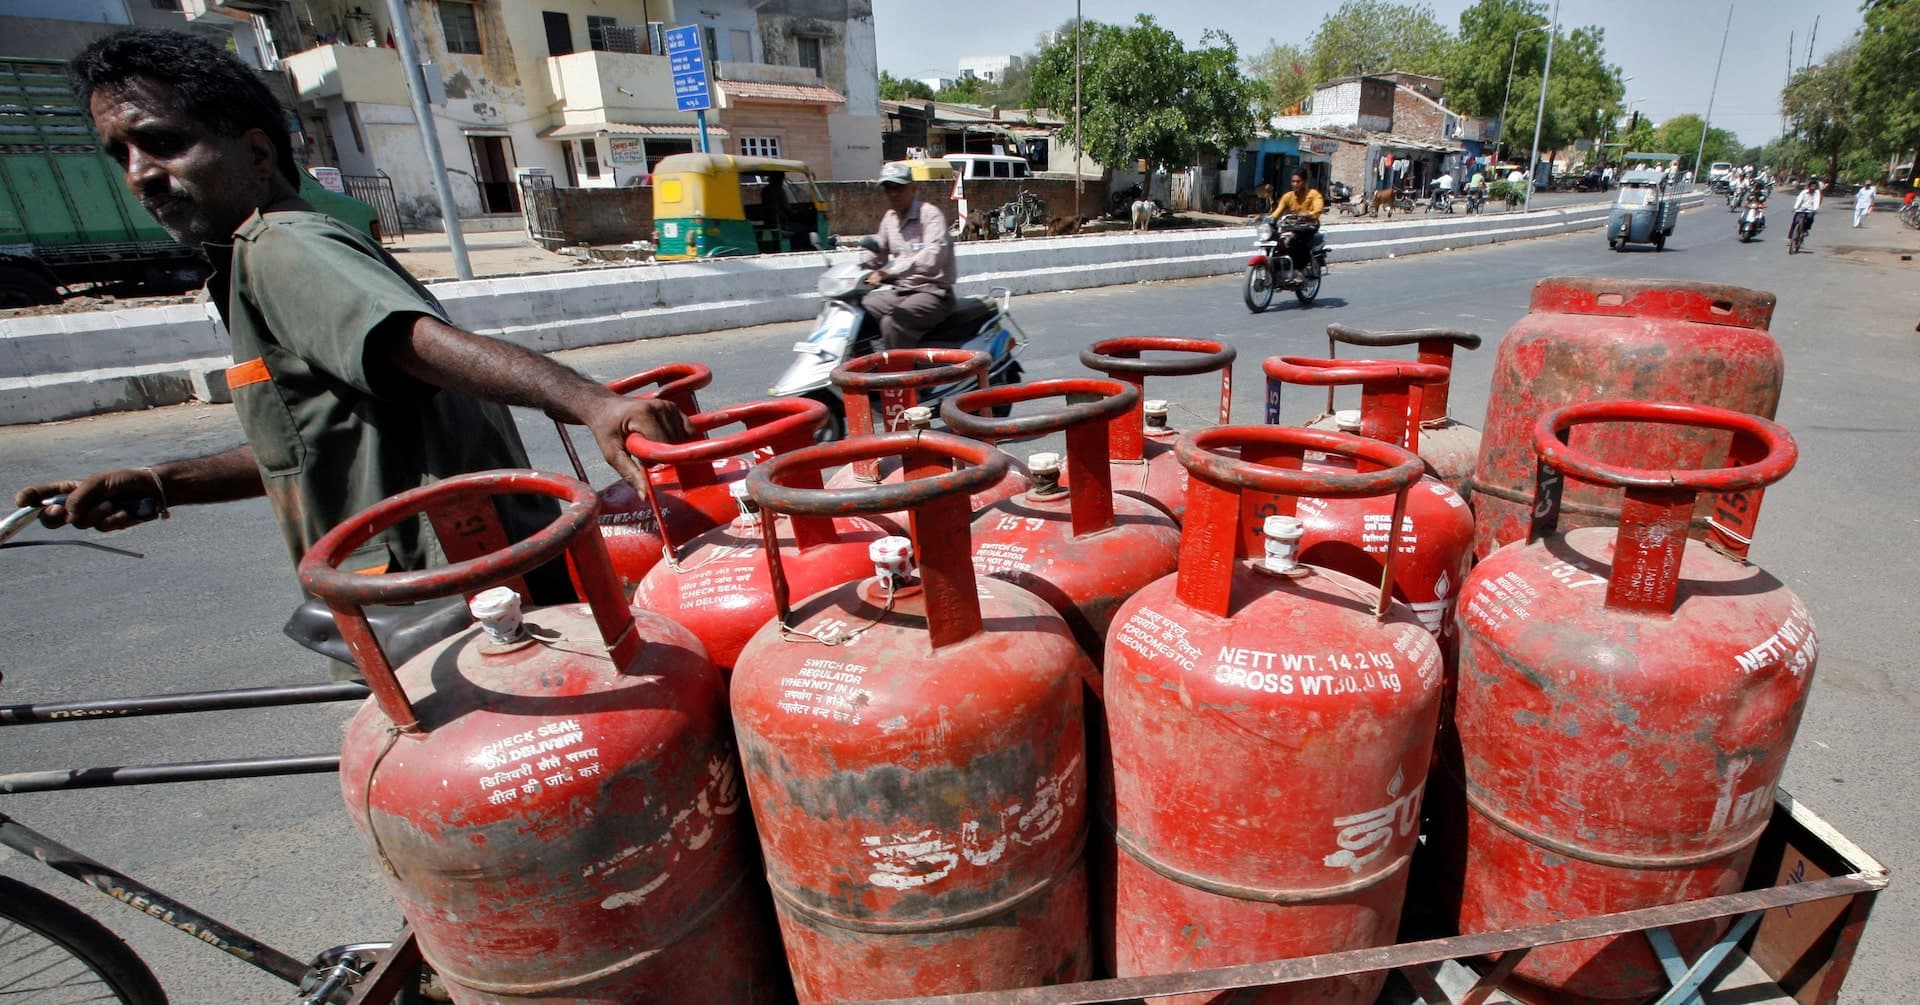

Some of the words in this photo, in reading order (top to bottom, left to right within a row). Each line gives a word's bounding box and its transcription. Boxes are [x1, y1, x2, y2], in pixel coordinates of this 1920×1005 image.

[976, 549, 1024, 560] REGULATOR
[681, 588, 715, 600] CHECK
[1495, 577, 1531, 606] REGULATOR
[1513, 606, 1531, 620] USE
[804, 659, 843, 669] SWITCH
[845, 663, 868, 674] OFF
[1218, 646, 1277, 670] NETT
[1281, 654, 1324, 672] WT.
[1327, 652, 1369, 671] 14.2
[1369, 651, 1394, 669] kg
[1734, 633, 1784, 674] NETT
[781, 677, 810, 688] WHEN
[811, 678, 833, 691] NOT
[835, 684, 847, 694] IN
[848, 686, 873, 698] USE
[799, 668, 862, 685] REGULATOR
[1215, 664, 1293, 695] GROSS
[1379, 671, 1401, 693] kg
[481, 730, 536, 756] CHECK
[537, 719, 580, 737] SEAL
[510, 731, 583, 761] DELIVERY
[536, 755, 561, 771] लेते
[565, 748, 599, 763] समय
[488, 788, 518, 805] सील
[520, 778, 540, 794] की
[578, 762, 600, 778] करें
[110, 887, 221, 946] NEELAM
